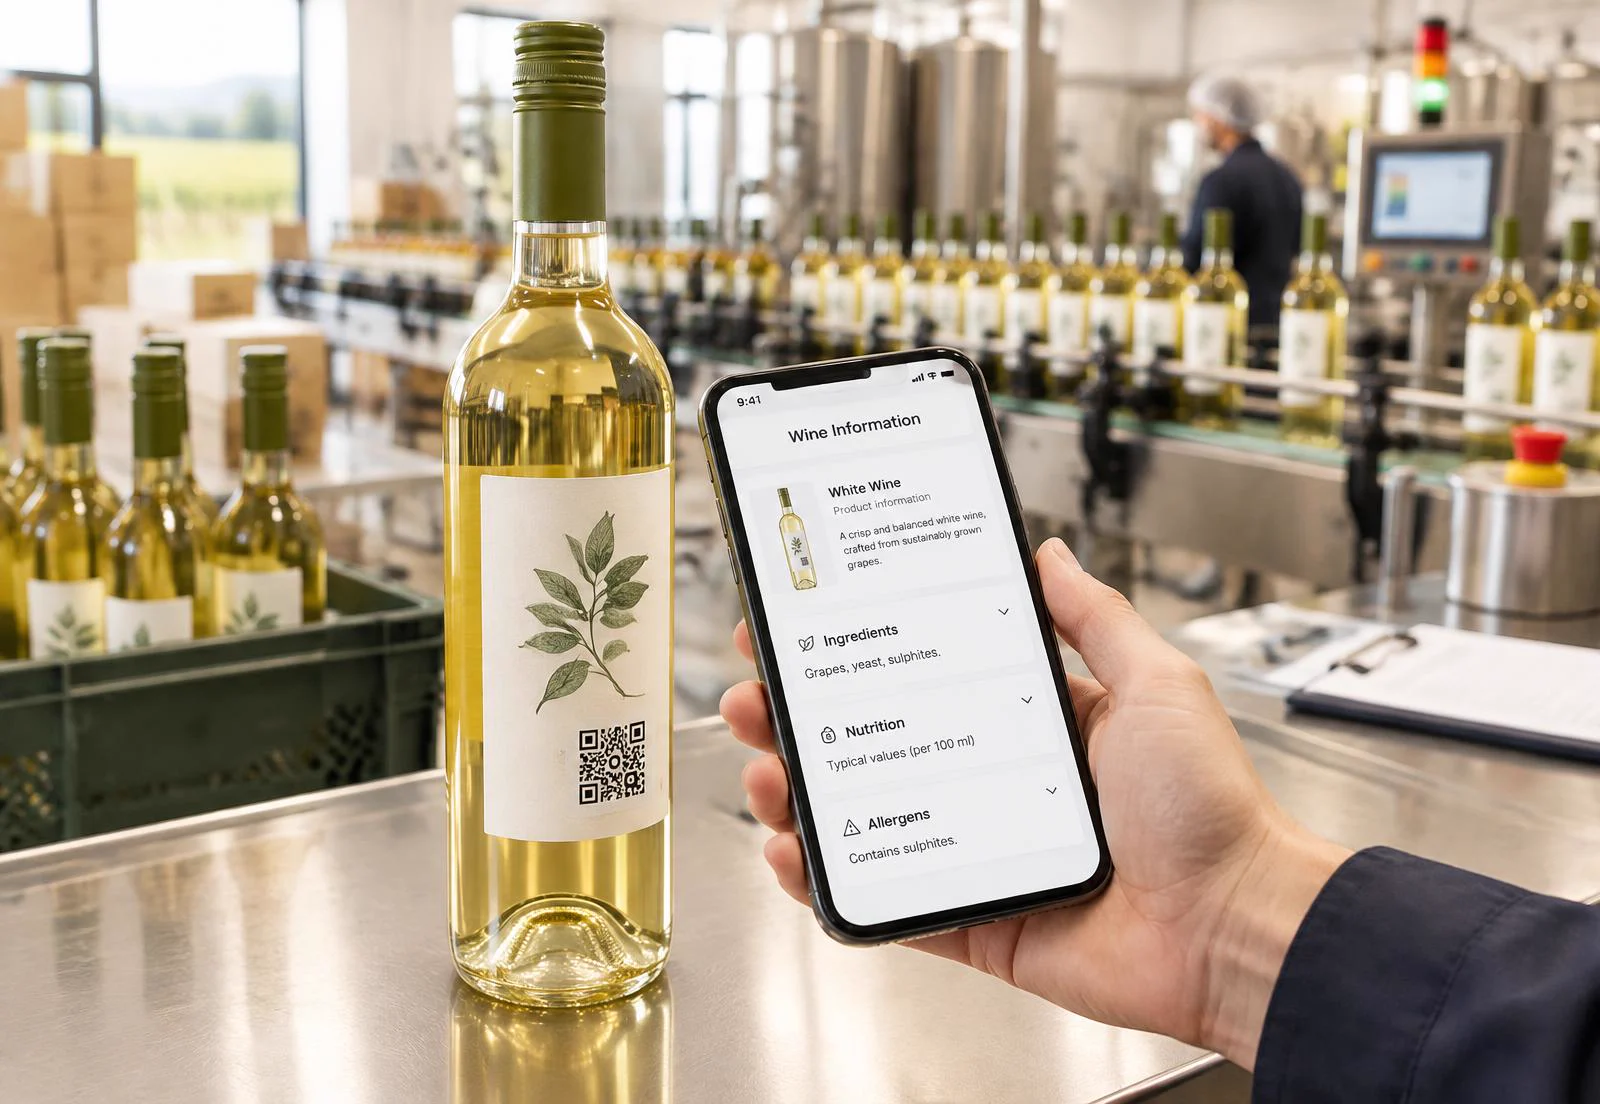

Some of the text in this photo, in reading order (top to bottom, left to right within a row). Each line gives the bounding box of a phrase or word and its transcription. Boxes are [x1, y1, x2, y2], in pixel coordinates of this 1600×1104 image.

[736, 394, 761, 408] 9:41
[787, 414, 922, 444] Wine Information
[827, 479, 902, 499] White Wine
[833, 493, 932, 516] Product information
[839, 511, 986, 541] A crisp and balanced white wine,
[843, 526, 982, 555] crafted from sustainably grown
[847, 558, 883, 572] grapes.
[823, 624, 899, 647] Ingredients
[804, 648, 942, 680] Grapes, yeast, sulphites.
[845, 719, 906, 739] Nutrition
[825, 734, 974, 772] Typical values (per 100 ml)
[868, 809, 931, 830] Allergens
[848, 836, 958, 865] Contains sulphites.
